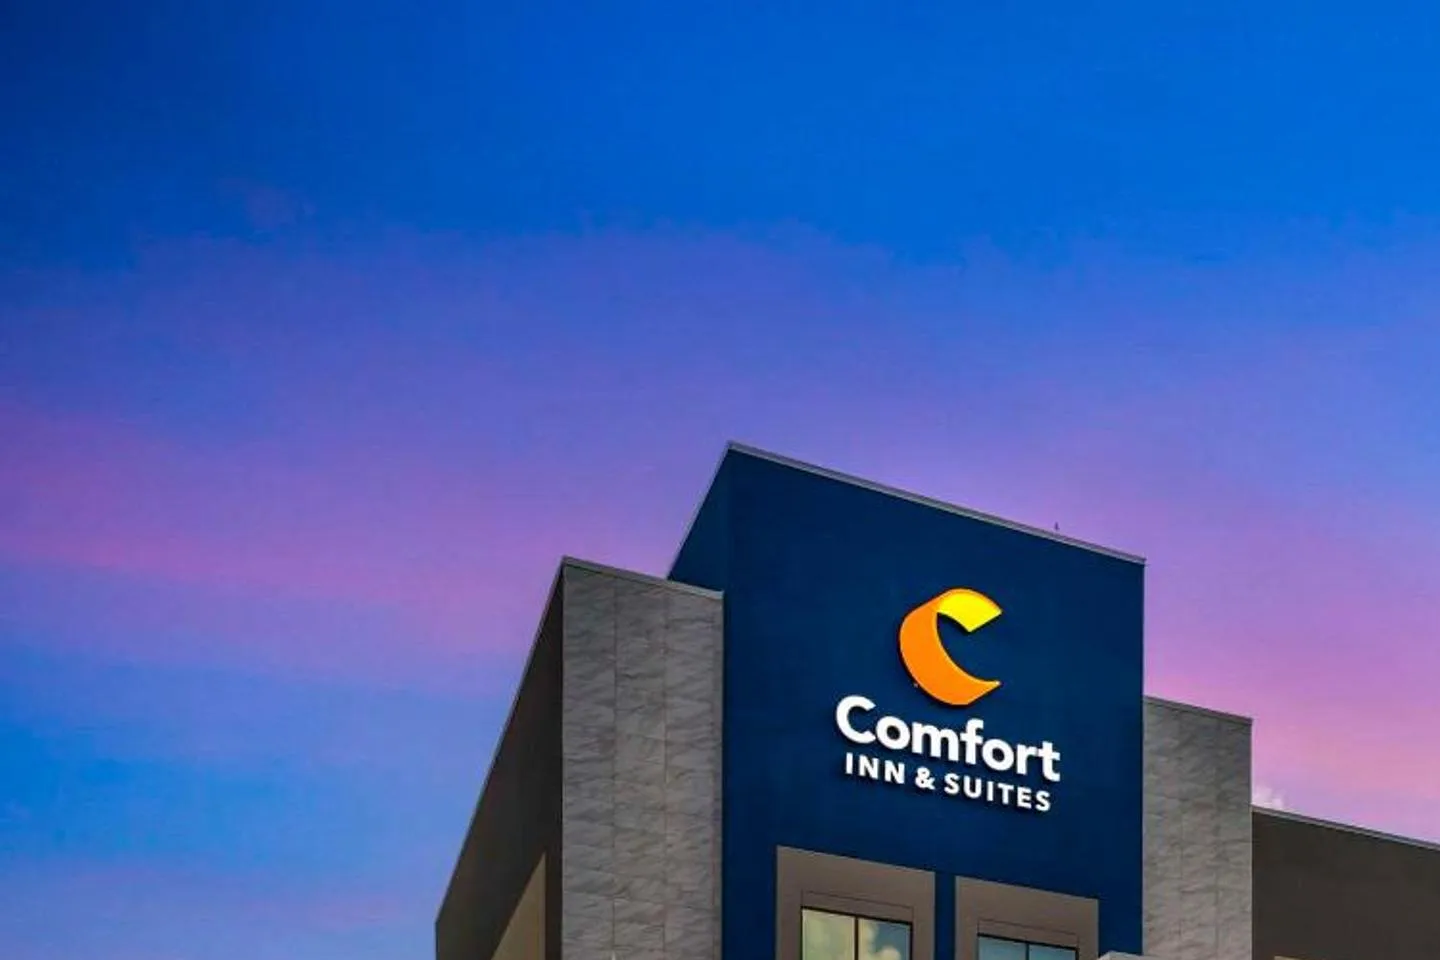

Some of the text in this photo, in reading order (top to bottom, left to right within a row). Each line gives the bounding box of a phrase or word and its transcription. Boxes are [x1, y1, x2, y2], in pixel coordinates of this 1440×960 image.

[836, 695, 1061, 782] Comfort
[845, 752, 1051, 812] INN & SUITES
